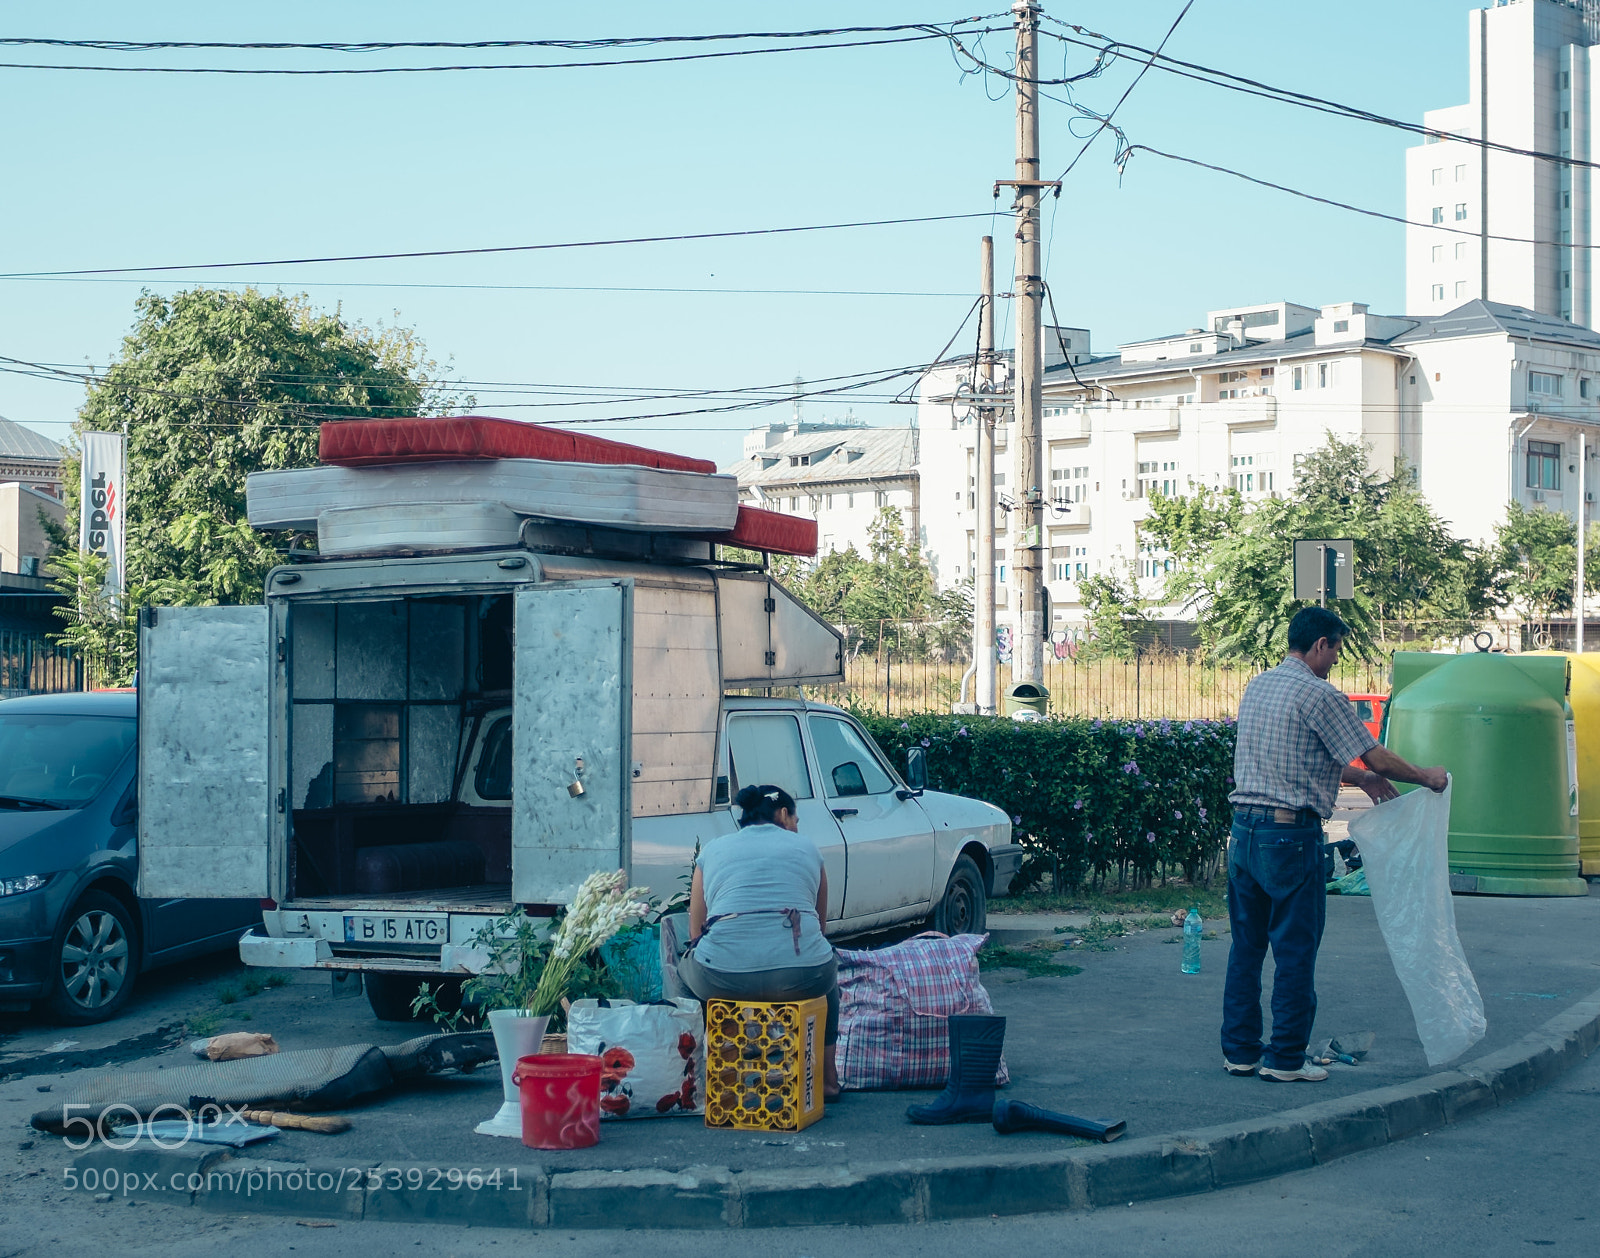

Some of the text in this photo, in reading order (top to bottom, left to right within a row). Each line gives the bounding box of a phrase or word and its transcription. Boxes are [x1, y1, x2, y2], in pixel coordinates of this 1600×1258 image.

[363, 919, 438, 940] B 15 ATG
[804, 1021, 814, 1109] Bergenbier
